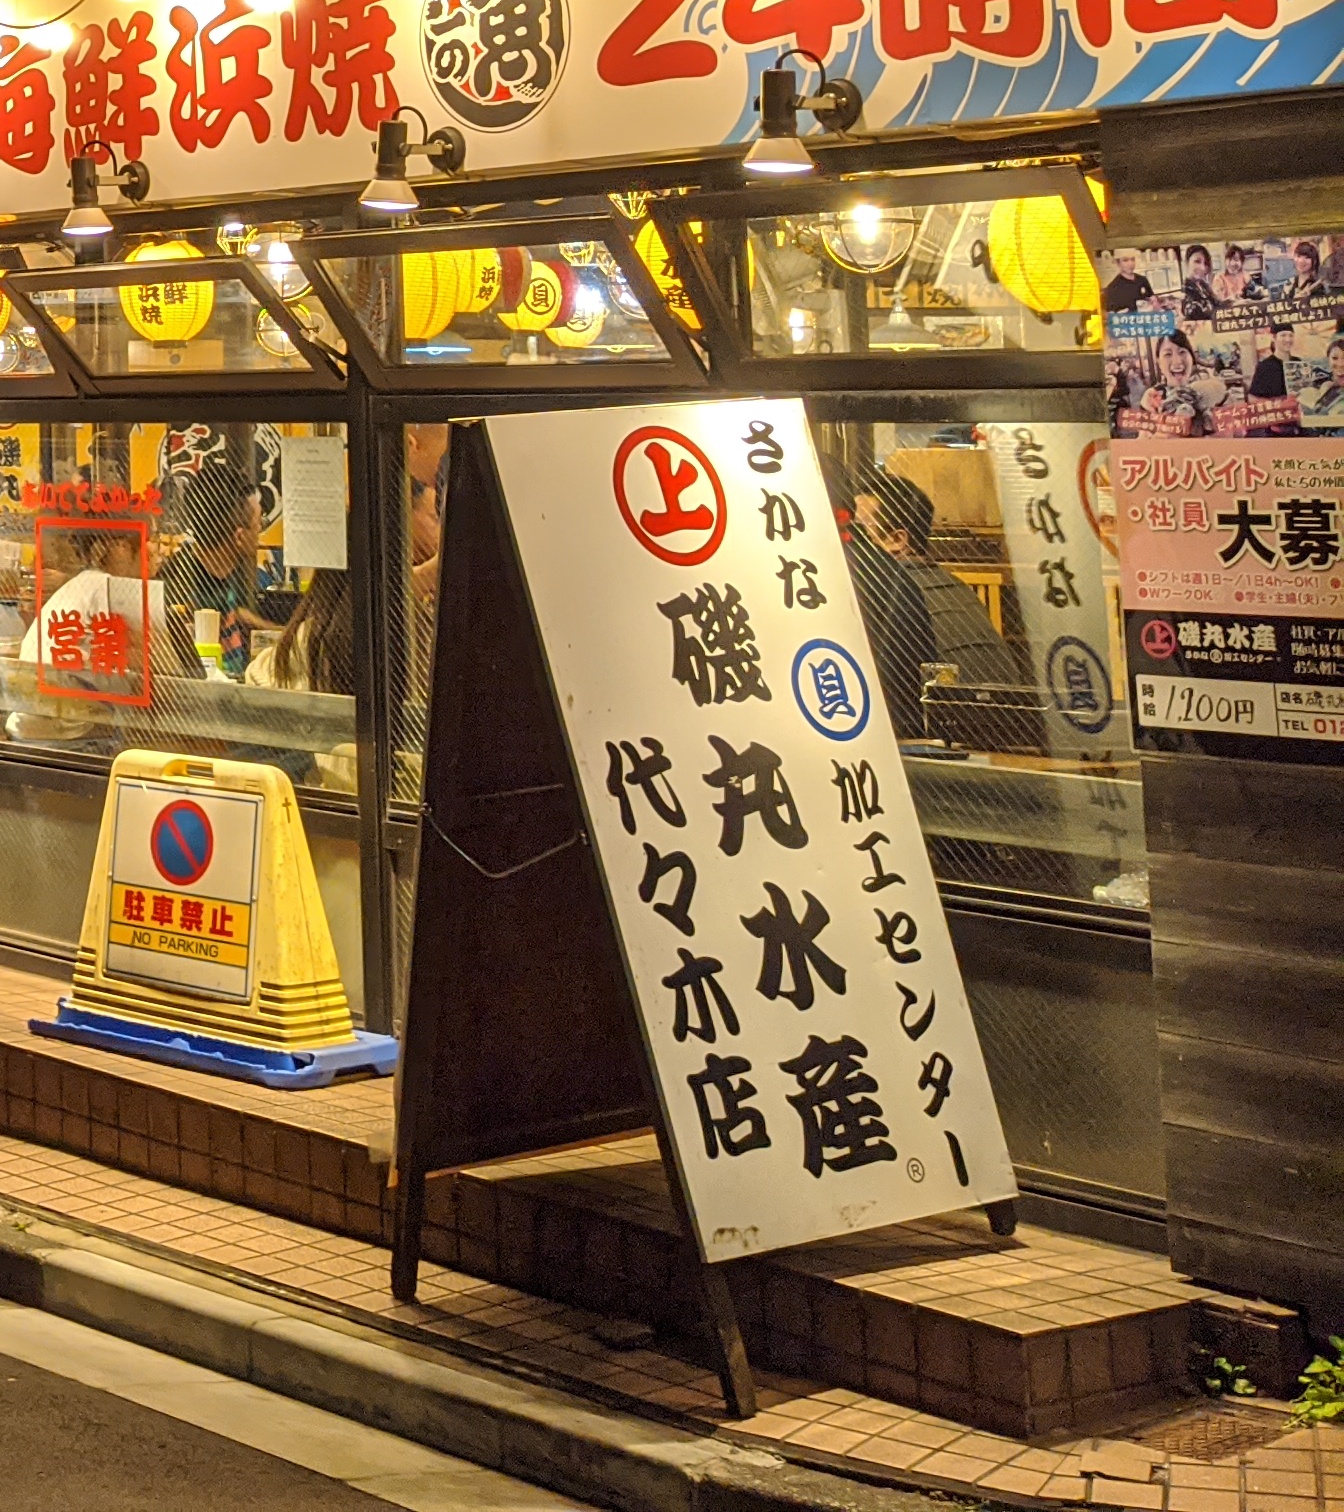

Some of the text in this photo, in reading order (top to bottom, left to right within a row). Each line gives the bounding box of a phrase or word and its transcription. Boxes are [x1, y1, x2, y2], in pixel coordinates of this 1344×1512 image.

[1121, 456, 1266, 490] アルバイト
[624, 432, 722, 561] 上
[48, 609, 131, 678] 営業
[1177, 620, 1278, 652] 磯丸水産
[1142, 683, 1156, 717] 時給
[1281, 691, 1303, 705] 店名
[1282, 719, 1309, 732] TEL
[741, 420, 827, 610] さかな
[831, 756, 971, 1187] 加工センター
[656, 582, 898, 1179] 磯丸水産
[123, 890, 234, 937] 駐車禁止
[132, 930, 219, 958] NO PARKING
[604, 736, 772, 1161] 代々木店
